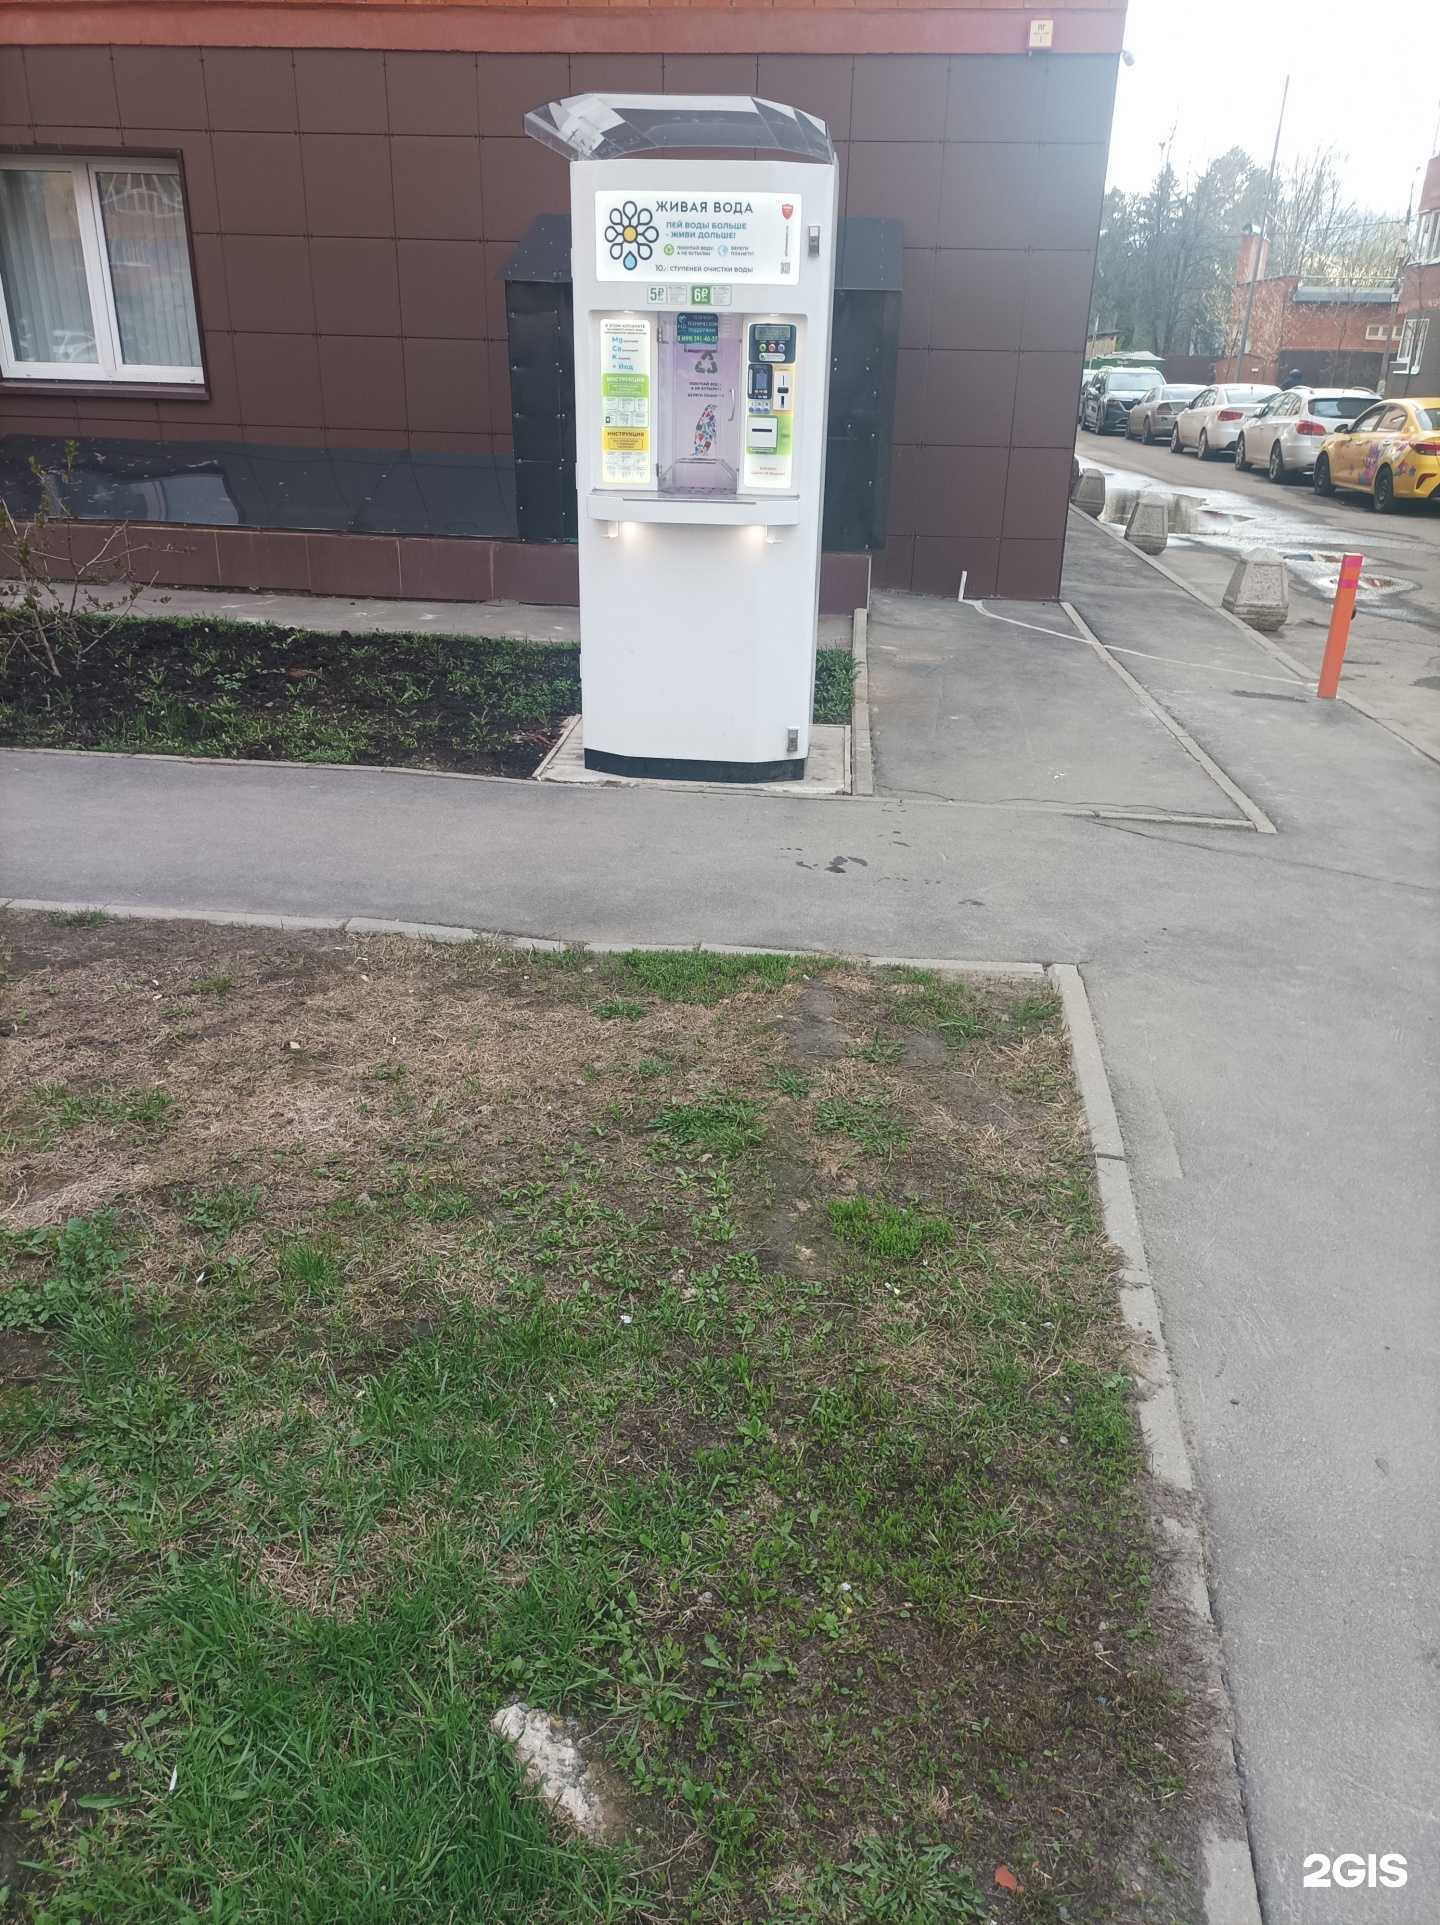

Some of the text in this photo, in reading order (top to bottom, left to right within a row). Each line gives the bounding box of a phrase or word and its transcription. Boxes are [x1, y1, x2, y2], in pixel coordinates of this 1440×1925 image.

[656, 201, 753, 215] ЖИВАЯ ВОДА
[666, 220, 746, 230] ПЕЙ ВОДЫ БОЛЬШЕ
[671, 230, 696, 239] ЖИВИ
